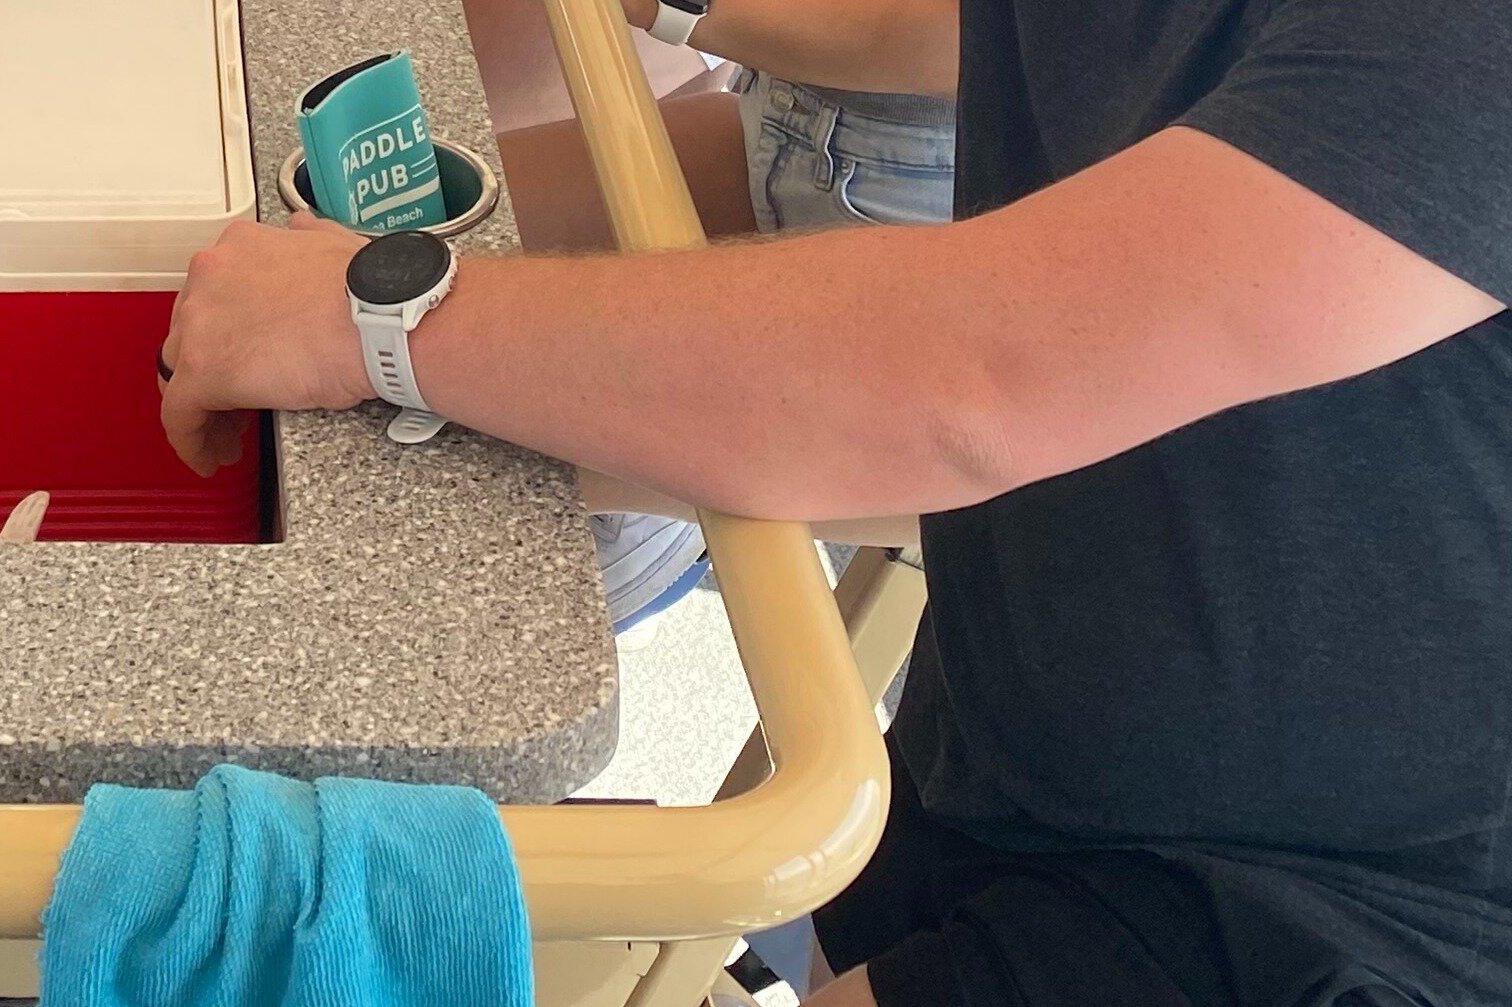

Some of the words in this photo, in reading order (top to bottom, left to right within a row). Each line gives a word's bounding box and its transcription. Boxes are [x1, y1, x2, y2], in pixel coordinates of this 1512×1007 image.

[342, 116, 426, 183] PADDLE
[357, 163, 409, 204] PUB
[387, 207, 424, 228] Beach
